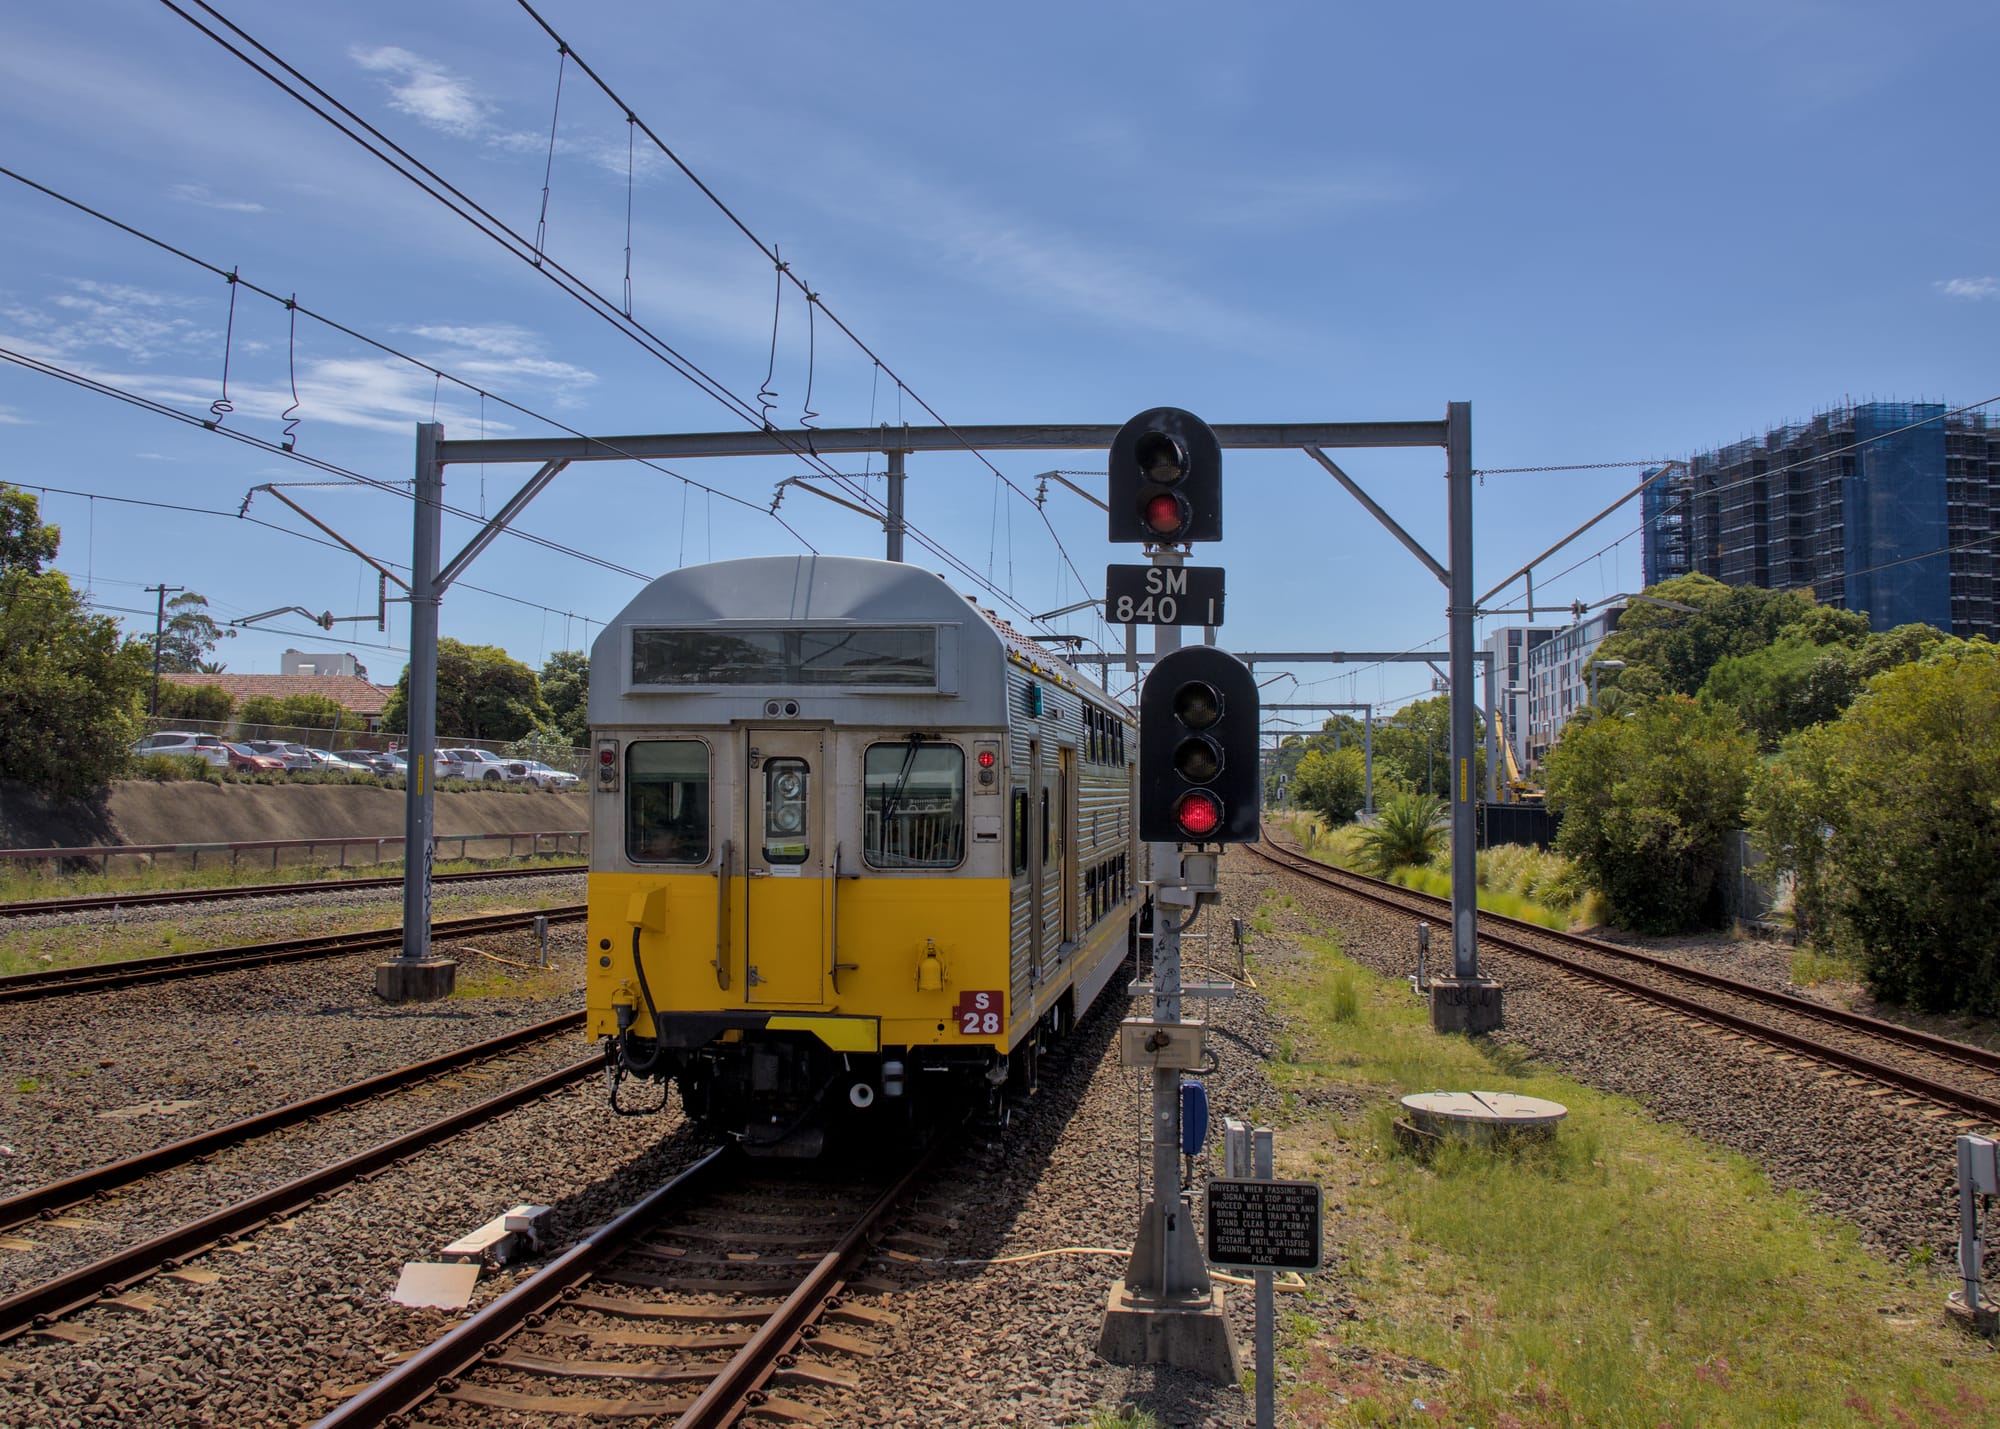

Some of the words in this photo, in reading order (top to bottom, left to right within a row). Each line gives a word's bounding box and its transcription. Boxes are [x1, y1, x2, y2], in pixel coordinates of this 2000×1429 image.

[1145, 567, 1187, 595] SM
[1116, 595, 1177, 623] 840
[975, 992, 990, 1010] S
[963, 1012, 999, 1034] 28
[1210, 1184, 1239, 1192] DRIVERS
[1267, 1186, 1296, 1194] PASSING
[1212, 1202, 1242, 1210] PROCEED
[1267, 1204, 1296, 1212] CAUTION
[1243, 1211, 1262, 1219] THEIR
[1267, 1212, 1287, 1220] TRAIN
[1243, 1220, 1264, 1228] CLEAR
[1269, 1221, 1277, 1229] OF
[1283, 1222, 1310, 1230] PERWAY
[1217, 1236, 1246, 1244] RESTART
[1250, 1237, 1269, 1245] UNTIL
[1275, 1239, 1310, 1247] SATISFIED
[1218, 1245, 1251, 1253] SHUNTING
[1285, 1248, 1309, 1256] TAKING
